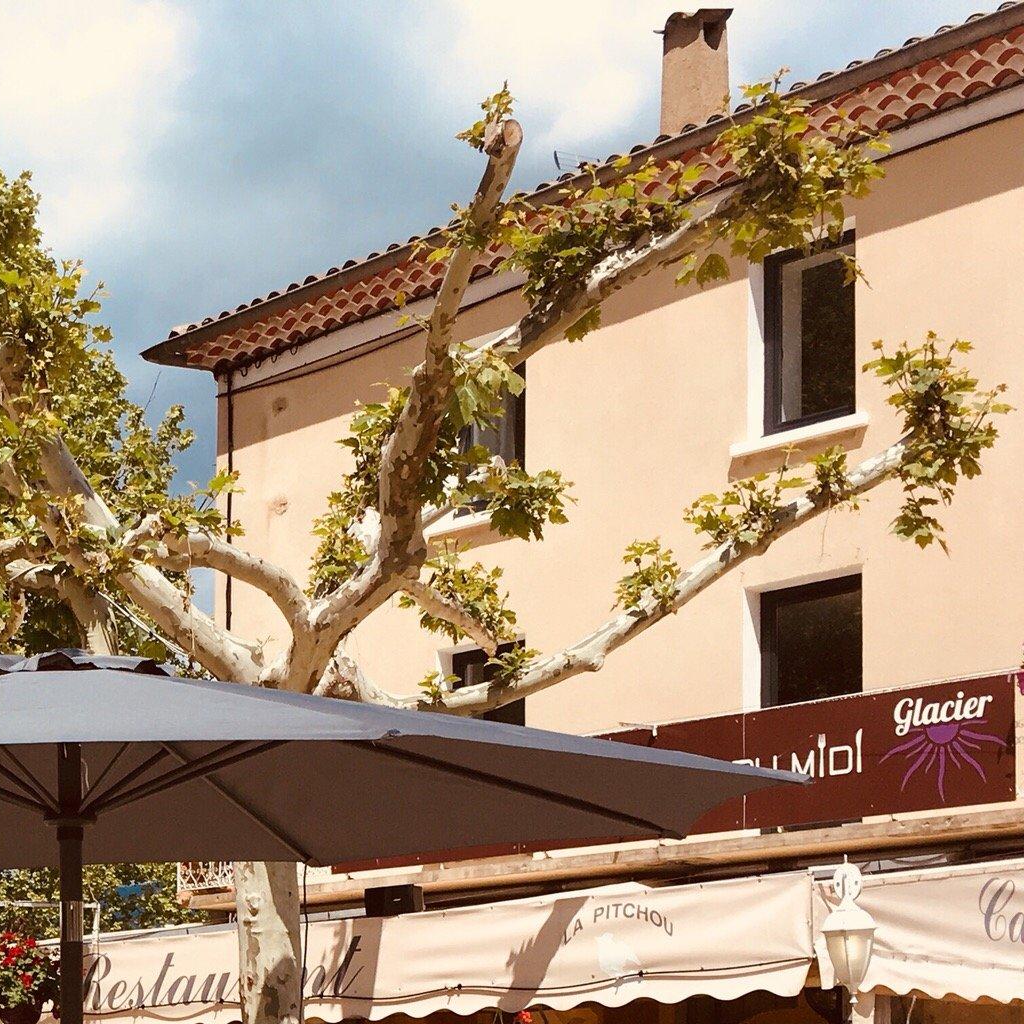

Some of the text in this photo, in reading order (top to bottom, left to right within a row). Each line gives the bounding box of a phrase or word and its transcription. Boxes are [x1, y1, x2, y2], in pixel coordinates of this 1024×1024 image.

[893, 691, 994, 736] Glacier
[563, 903, 673, 945] LA PITCHOU
